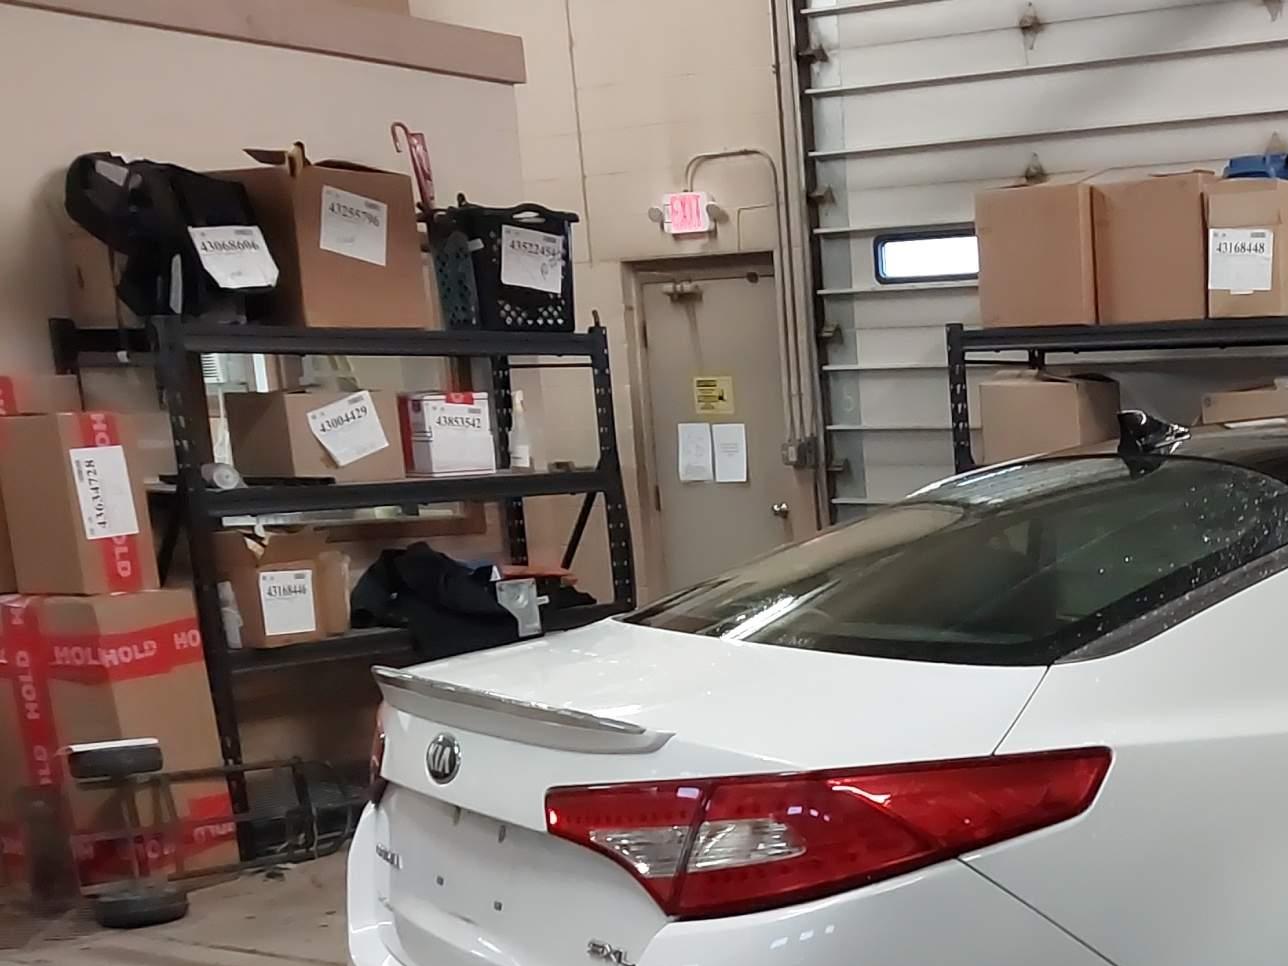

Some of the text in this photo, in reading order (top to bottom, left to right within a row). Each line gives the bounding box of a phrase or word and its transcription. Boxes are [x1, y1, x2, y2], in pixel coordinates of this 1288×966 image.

[1216, 242, 1265, 254] 43168448
[319, 406, 368, 433] 43004429
[436, 416, 481, 429] 43853542
[100, 640, 158, 668] HOLD
[16, 651, 40, 720] HOLD
